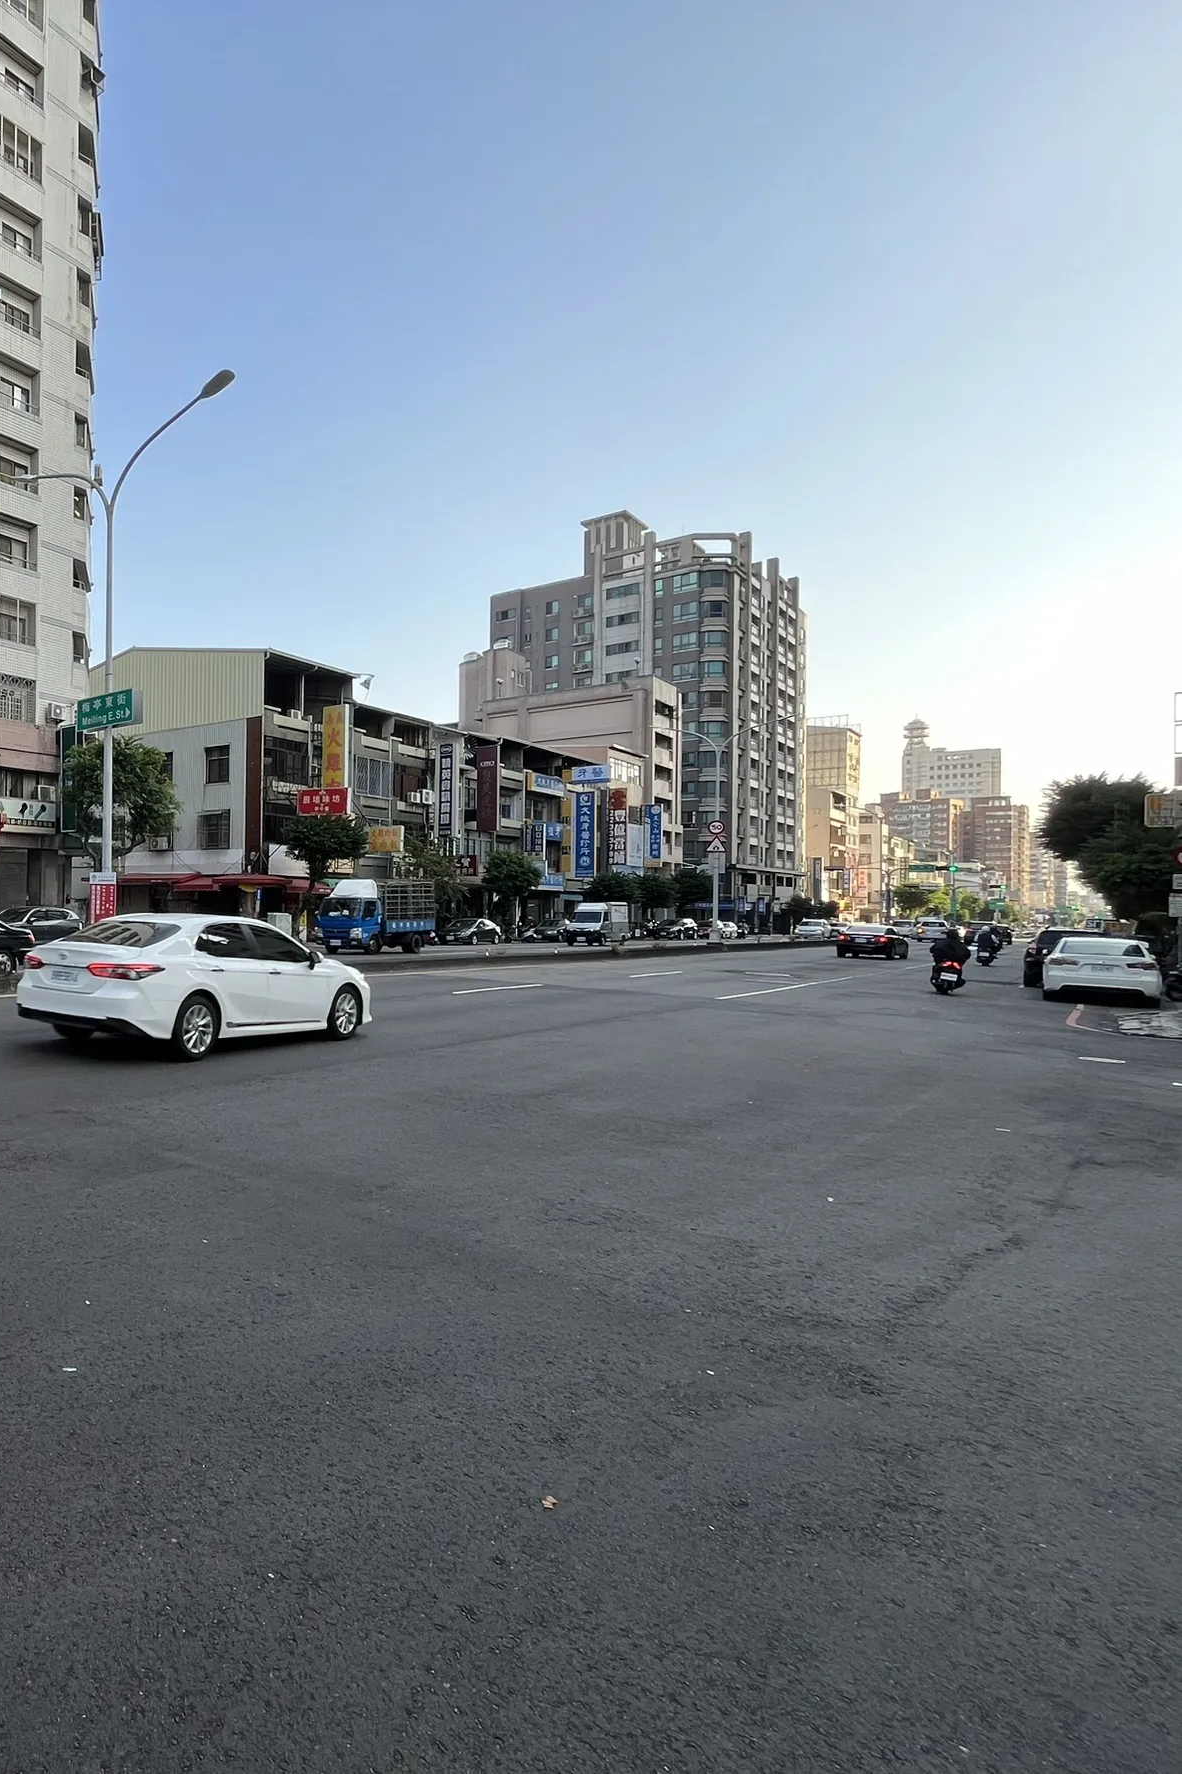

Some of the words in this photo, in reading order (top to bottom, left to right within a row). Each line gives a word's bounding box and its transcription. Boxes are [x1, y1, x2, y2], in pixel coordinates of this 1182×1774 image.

[82, 693, 126, 713] 梅亭東街
[578, 767, 604, 778] 牙醫
